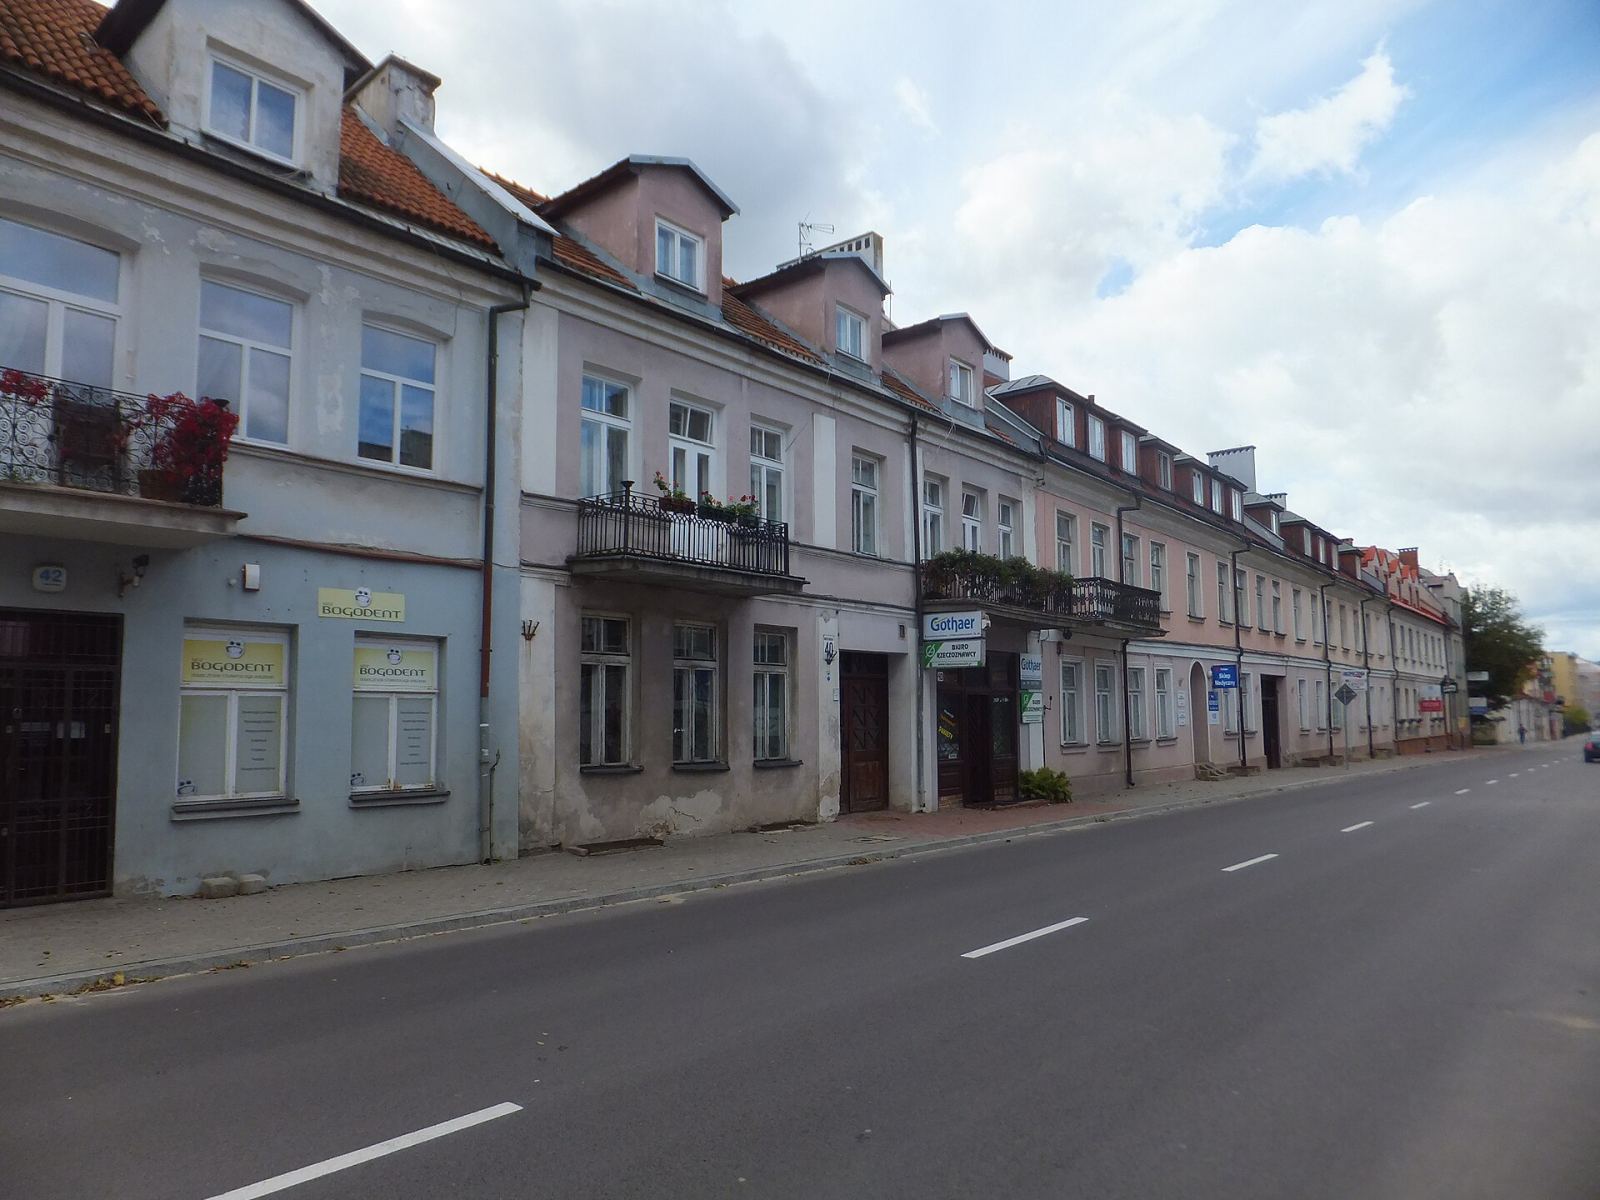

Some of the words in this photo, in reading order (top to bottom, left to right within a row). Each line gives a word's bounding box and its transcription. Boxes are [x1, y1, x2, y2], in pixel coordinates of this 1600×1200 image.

[40, 569, 62, 582] 42
[322, 605, 401, 618] BOGODENT
[931, 616, 975, 632] Gothaer
[951, 643, 969, 651] BIURO
[191, 661, 274, 672] BOGODENT
[1021, 657, 1041, 673] Gothaer
[360, 667, 426, 677] BOGODENT
